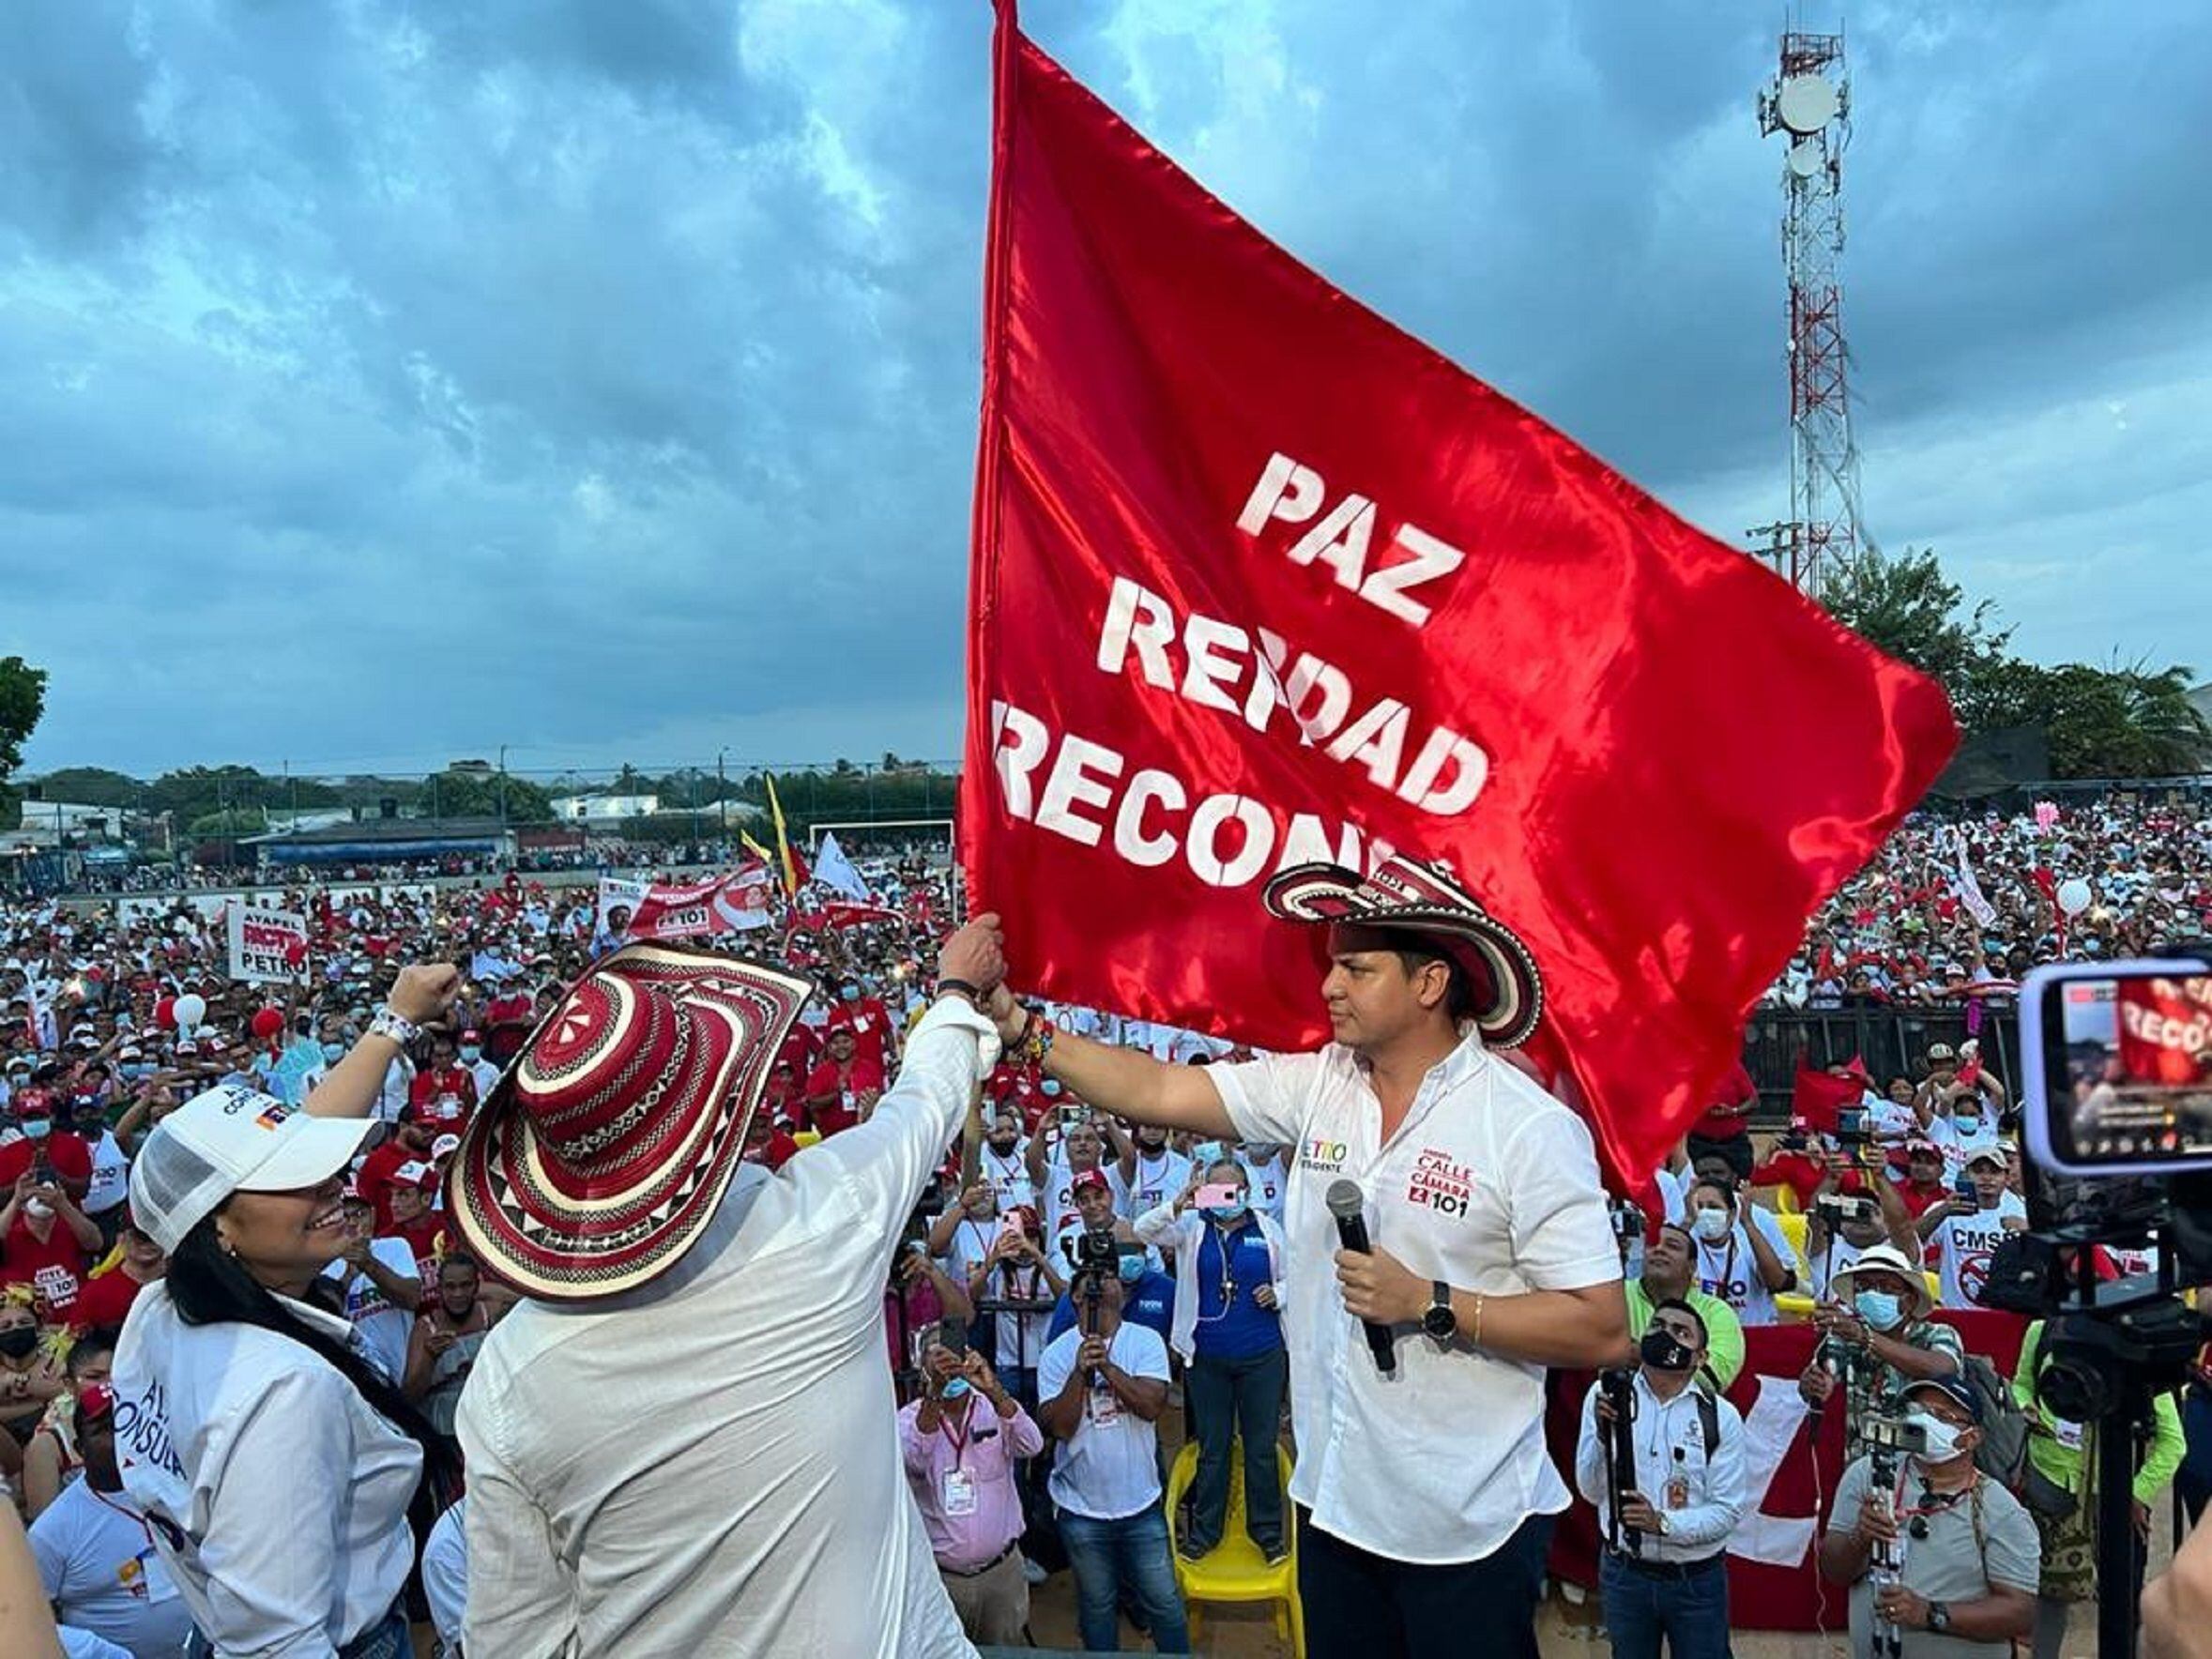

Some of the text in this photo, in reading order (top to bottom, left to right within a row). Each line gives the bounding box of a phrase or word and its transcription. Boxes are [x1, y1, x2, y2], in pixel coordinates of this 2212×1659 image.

[1236, 451, 1466, 626] PAZ
[992, 700, 1395, 888] RECON
[242, 951, 307, 975] PETRO
[1418, 1155, 1474, 1180] CALLE
[1433, 1191, 1469, 1219] 101
